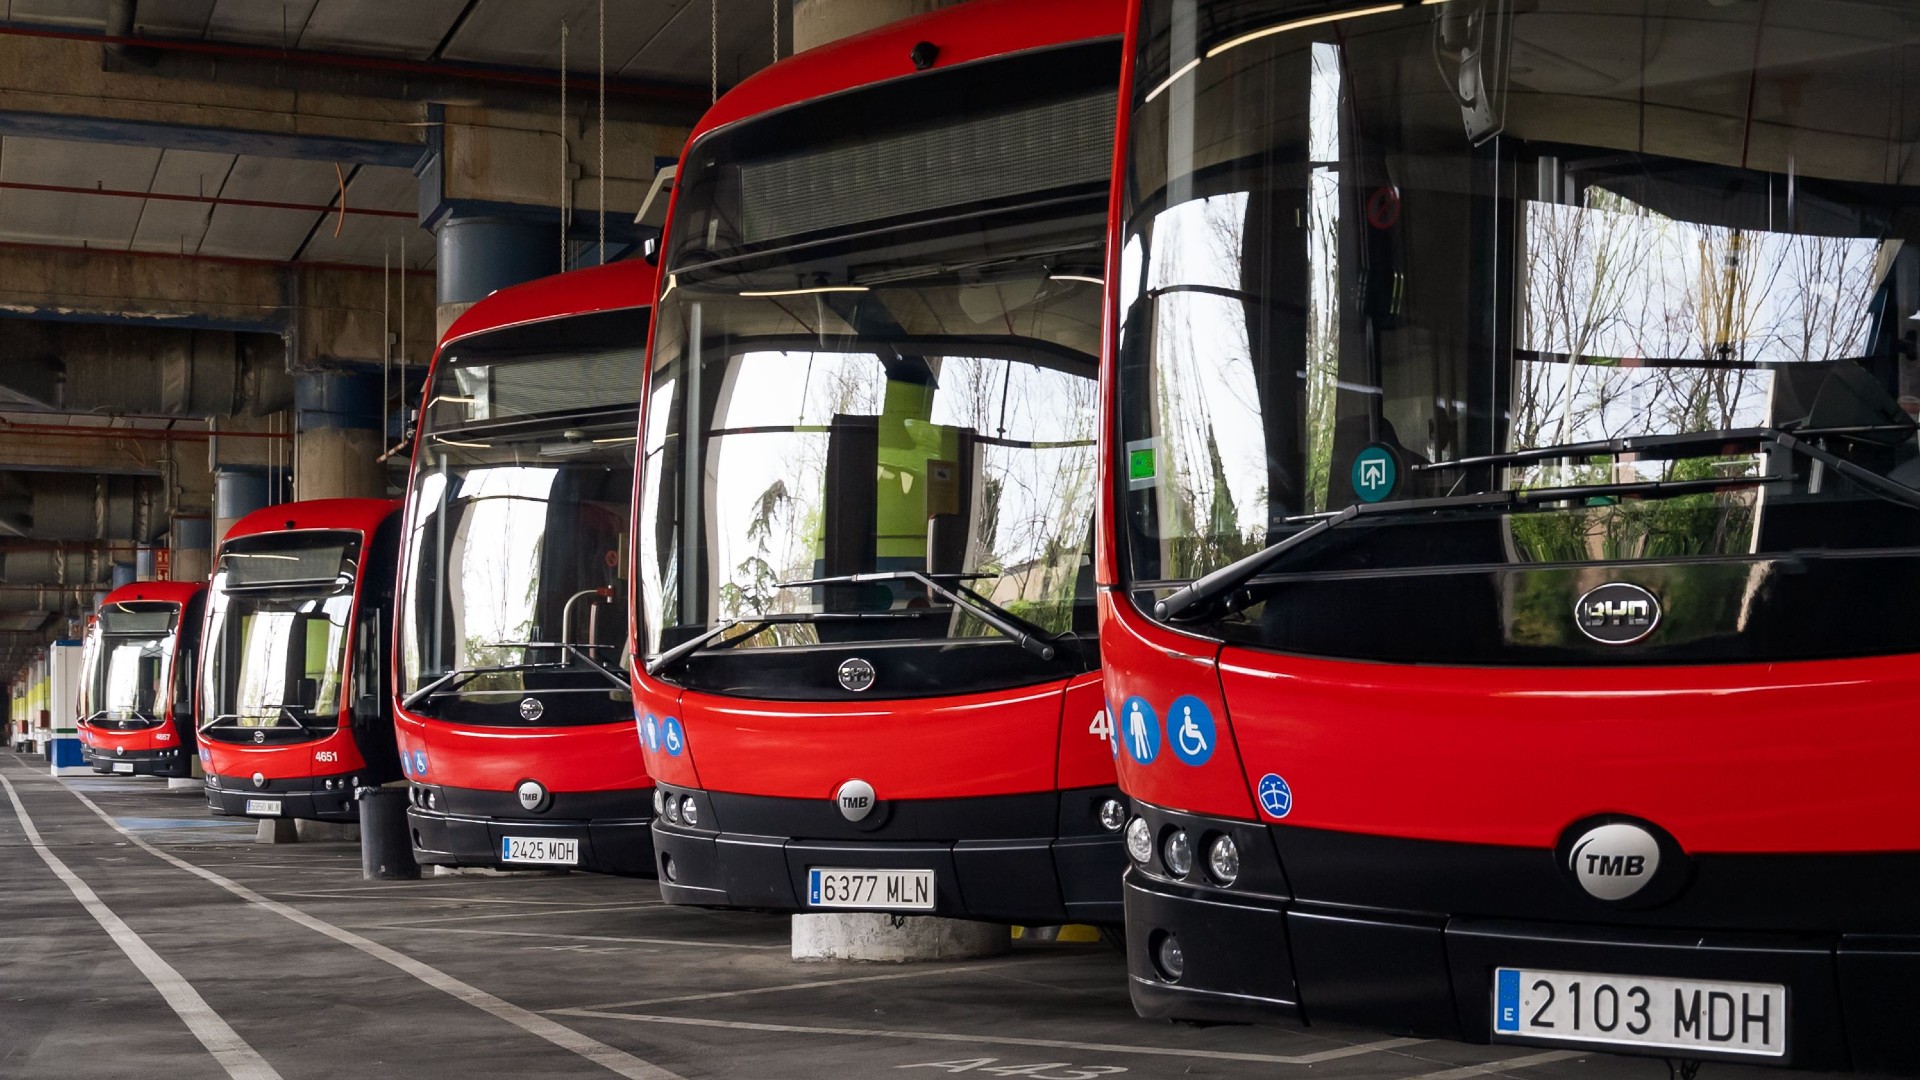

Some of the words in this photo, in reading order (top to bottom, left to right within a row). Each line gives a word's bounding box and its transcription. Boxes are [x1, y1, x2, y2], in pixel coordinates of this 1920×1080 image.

[1585, 600, 1649, 626] BYD
[1089, 710, 1109, 741] 4
[315, 751, 338, 762] 4651
[522, 793, 538, 801] TMB
[842, 796, 869, 809] TMB
[512, 841, 544, 859] 2425
[549, 842, 575, 860] MDH
[1586, 854, 1645, 876] TMB
[824, 875, 878, 902] 6377
[887, 875, 928, 903] MLN
[1504, 1007, 1514, 1021] E
[1529, 979, 1652, 1035] 2103
[1674, 987, 1771, 1045] MDH
[893, 1057, 1129, 1080] A43
